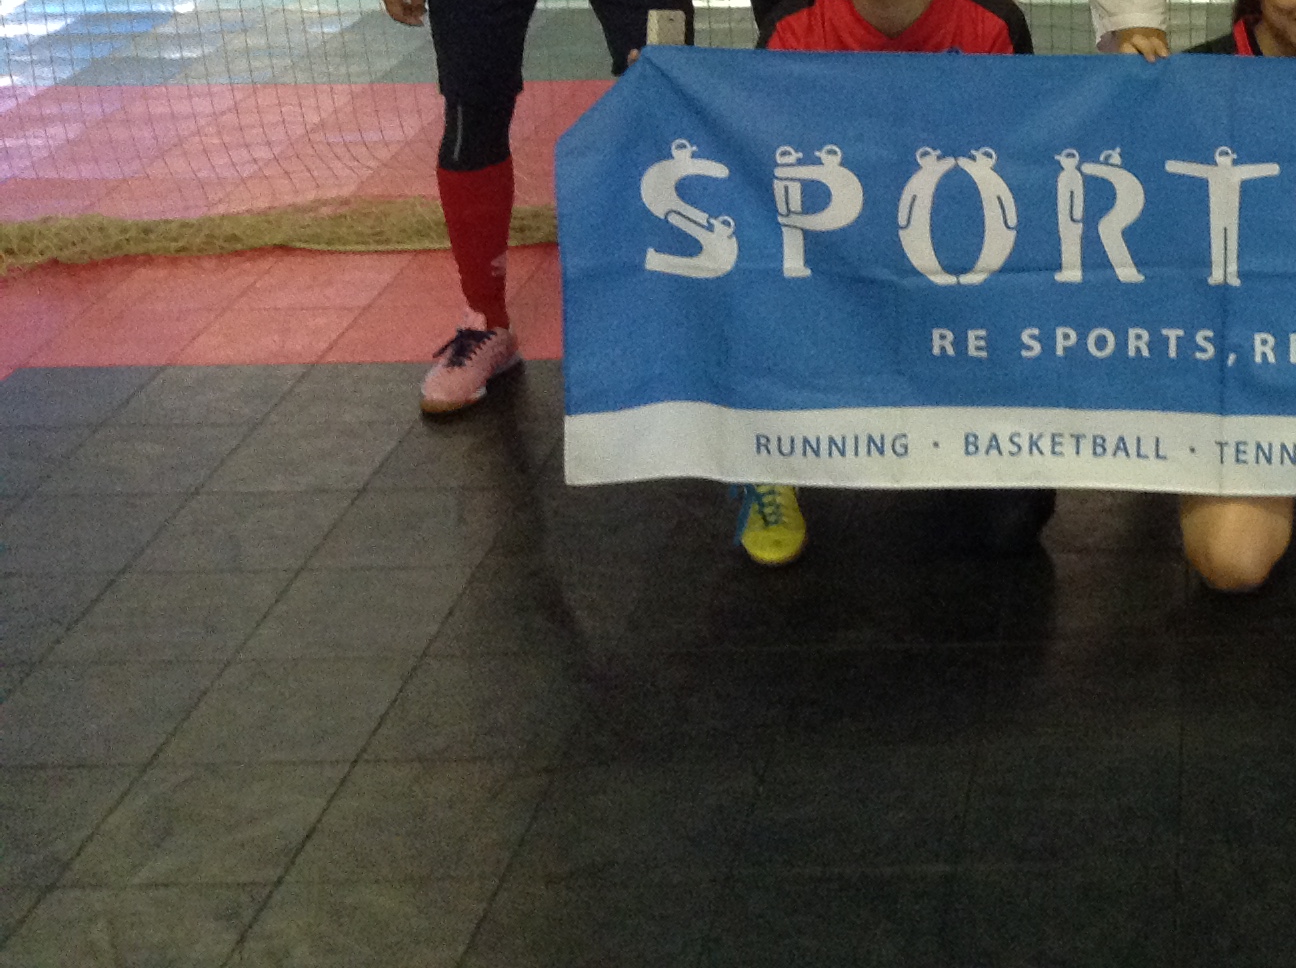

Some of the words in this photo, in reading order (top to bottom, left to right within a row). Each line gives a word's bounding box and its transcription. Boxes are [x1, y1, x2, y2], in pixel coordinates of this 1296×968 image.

[931, 328, 988, 359] RE
[755, 432, 911, 459] RUNNING
[963, 432, 1168, 461] BASKETBALL
